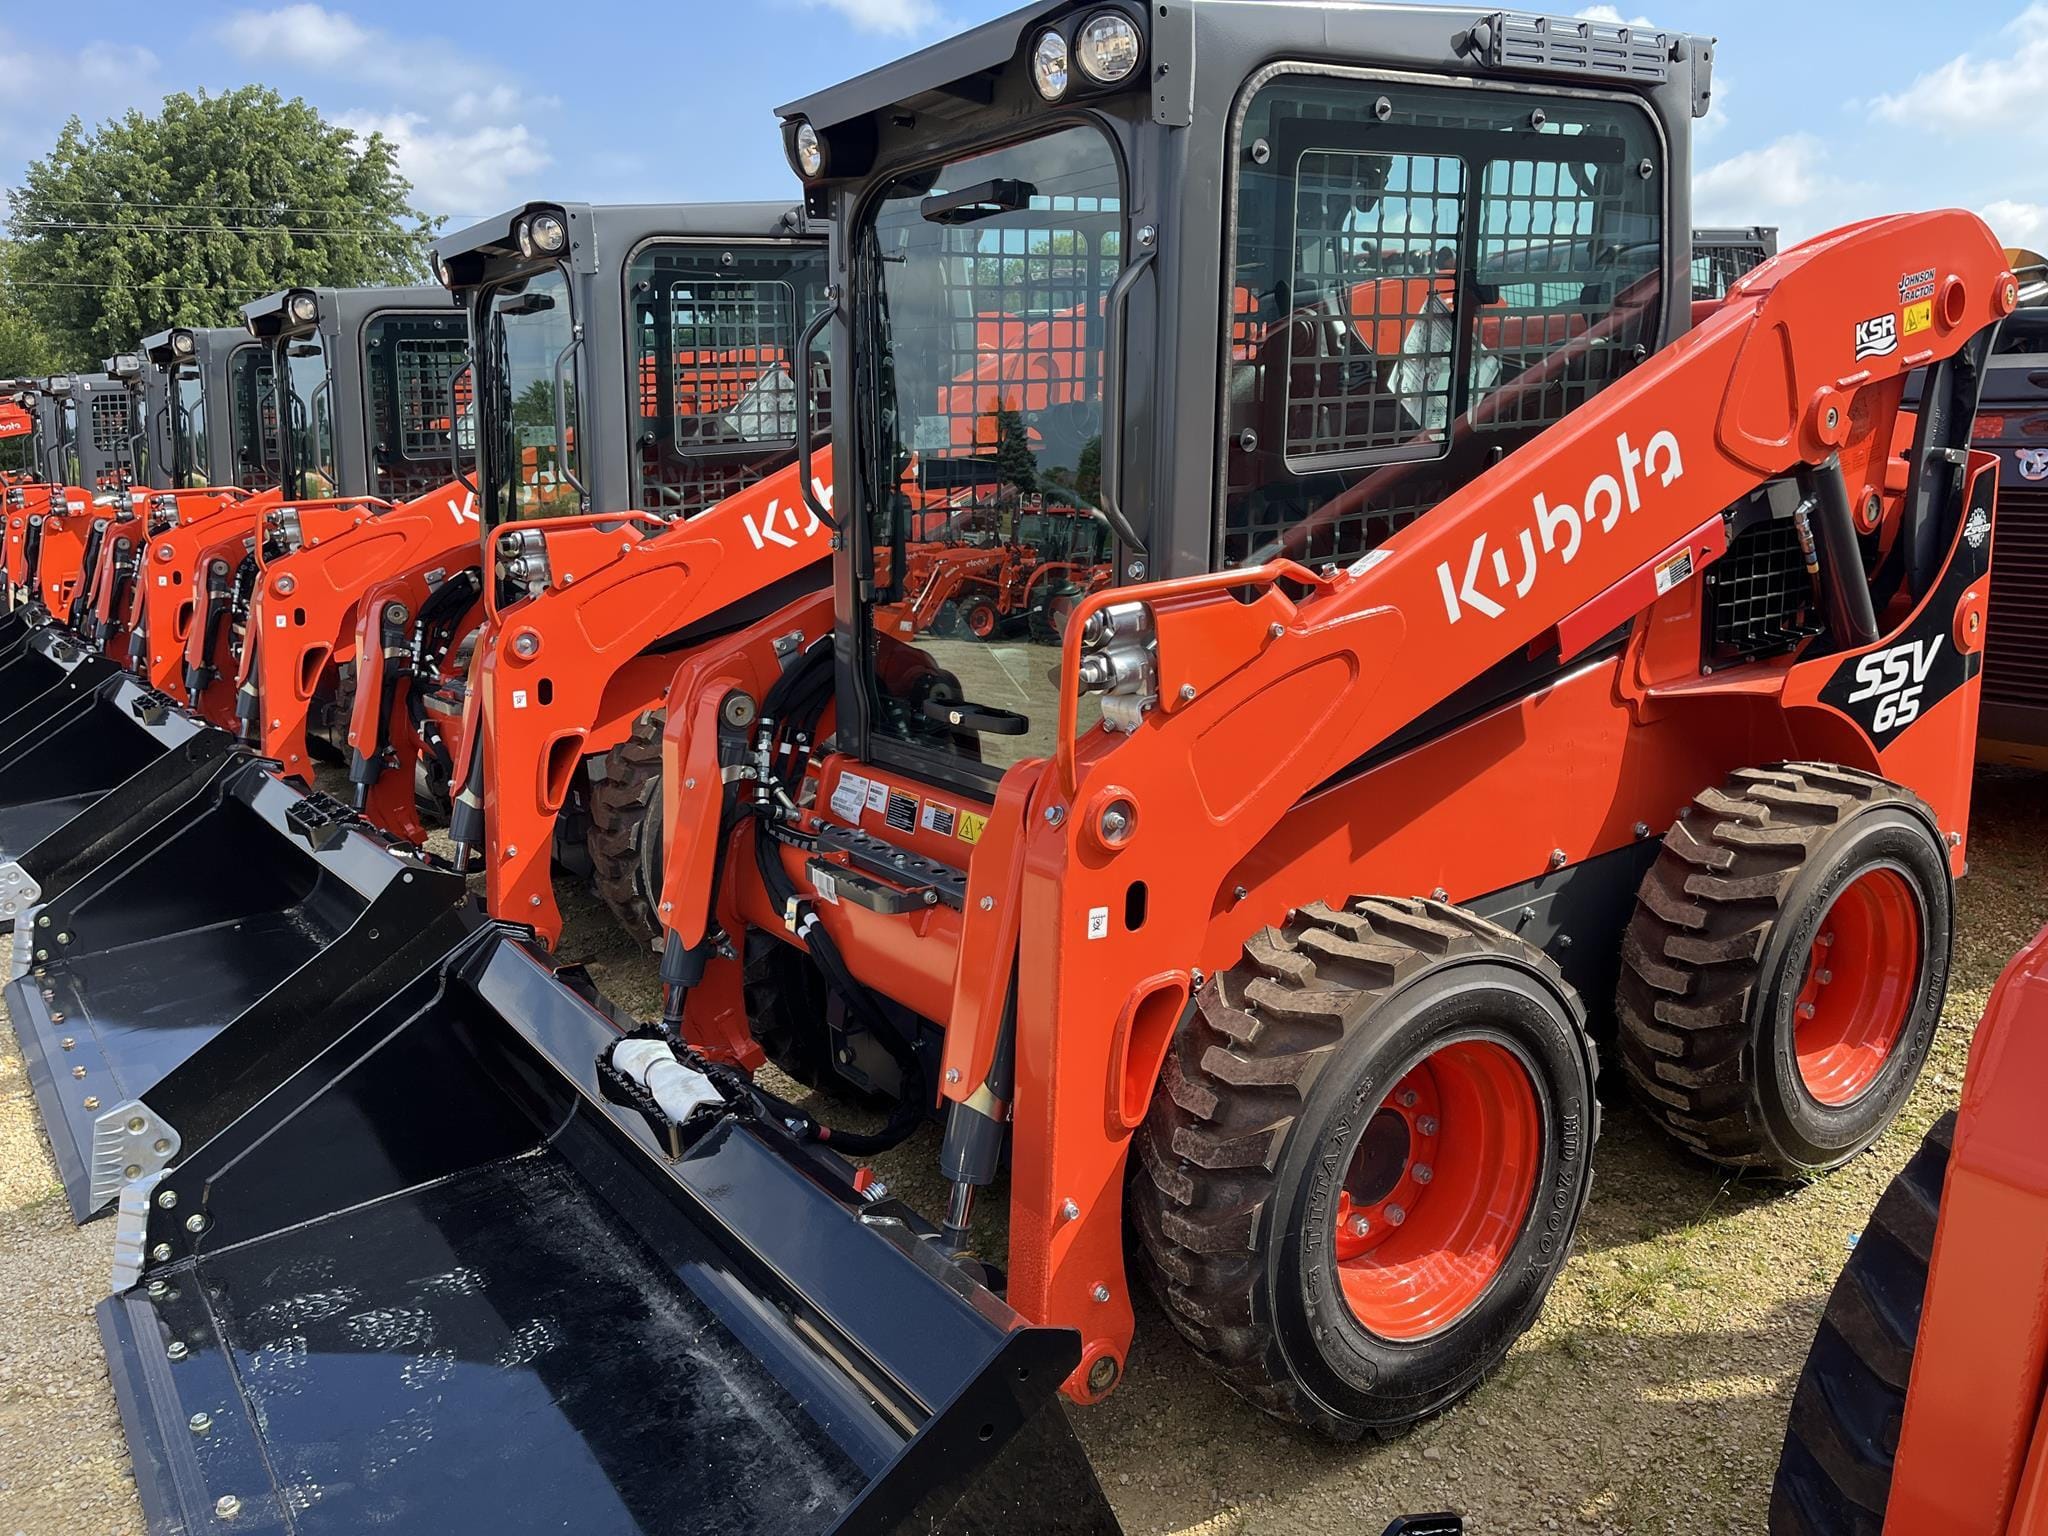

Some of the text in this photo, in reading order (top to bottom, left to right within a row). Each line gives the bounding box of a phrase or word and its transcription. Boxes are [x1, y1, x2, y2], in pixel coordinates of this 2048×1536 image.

[1899, 269, 1936, 289] JOHNSON
[1899, 284, 1935, 303] TRACTOR
[1856, 313, 1896, 345] KSR
[1436, 430, 1684, 625] Kubota
[1848, 633, 1945, 704] SSV
[1873, 685, 1924, 733] 65
[1304, 1117, 1352, 1255] TITAN
[1540, 1170, 1574, 1254] 2000
